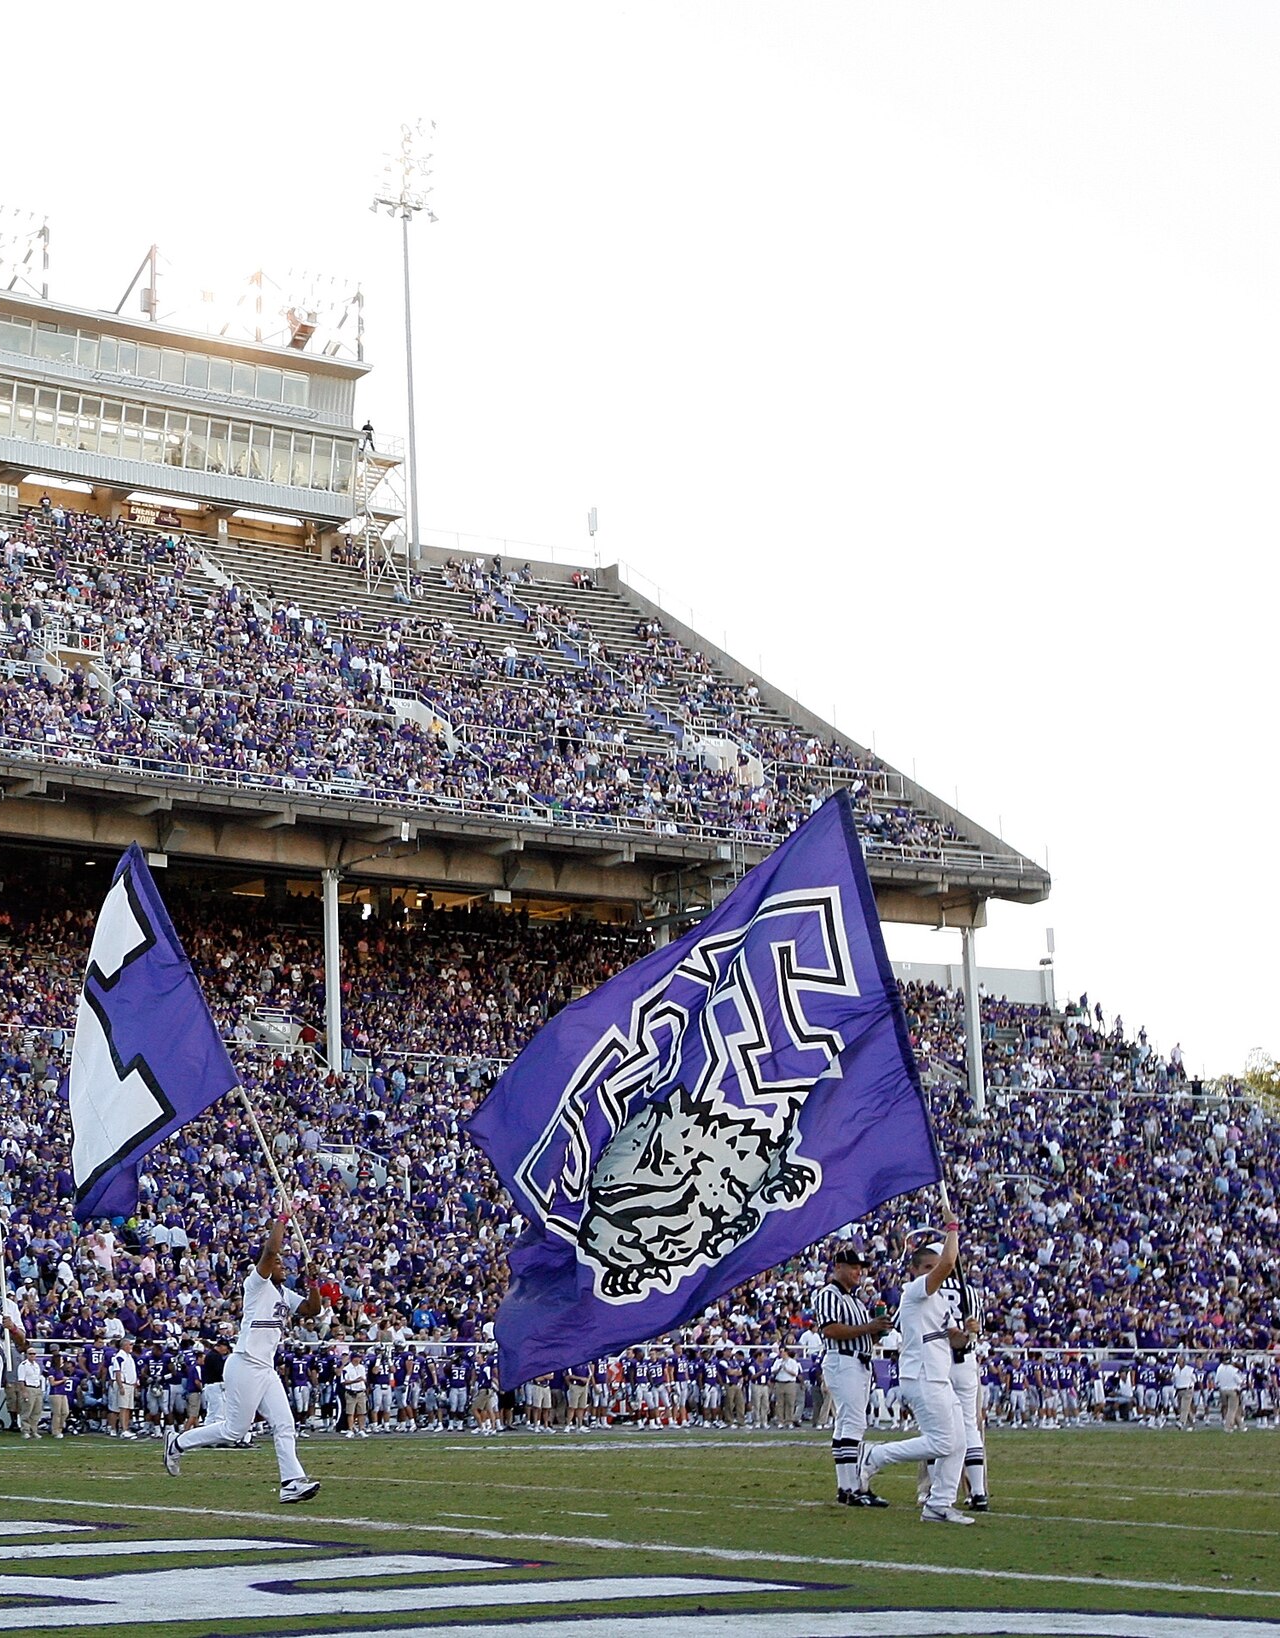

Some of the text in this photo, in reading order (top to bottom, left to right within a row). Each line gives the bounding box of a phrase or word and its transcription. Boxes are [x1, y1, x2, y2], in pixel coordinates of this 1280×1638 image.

[130, 505, 160, 518] ENERGY
[134, 514, 156, 525] ZONE
[451, 1368, 466, 1381] 32
